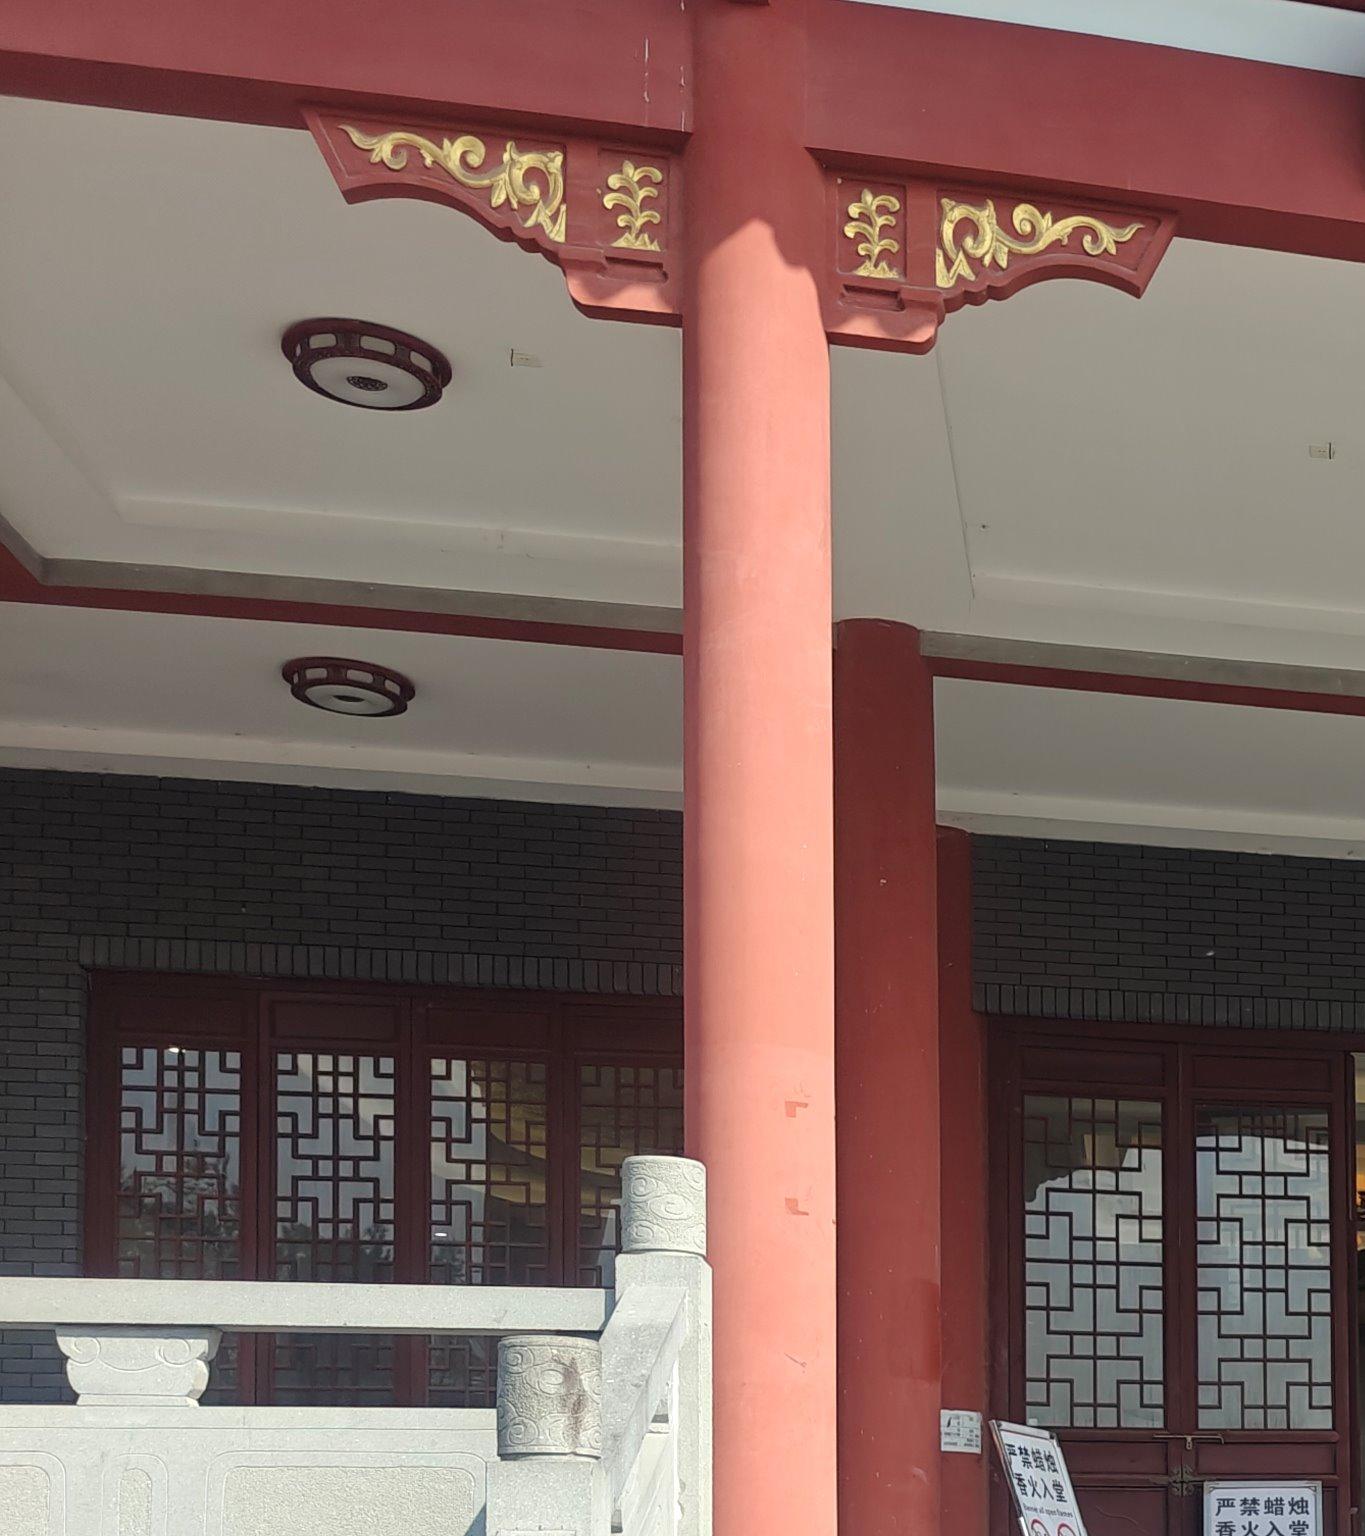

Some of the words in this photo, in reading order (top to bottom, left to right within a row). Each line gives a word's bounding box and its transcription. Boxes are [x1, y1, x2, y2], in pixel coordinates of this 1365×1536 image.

[1005, 1443, 1058, 1474] 严禁蜡烛
[1014, 1472, 1067, 1503] 香火入堂
[1215, 1496, 1310, 1516] 严禁蜡烛
